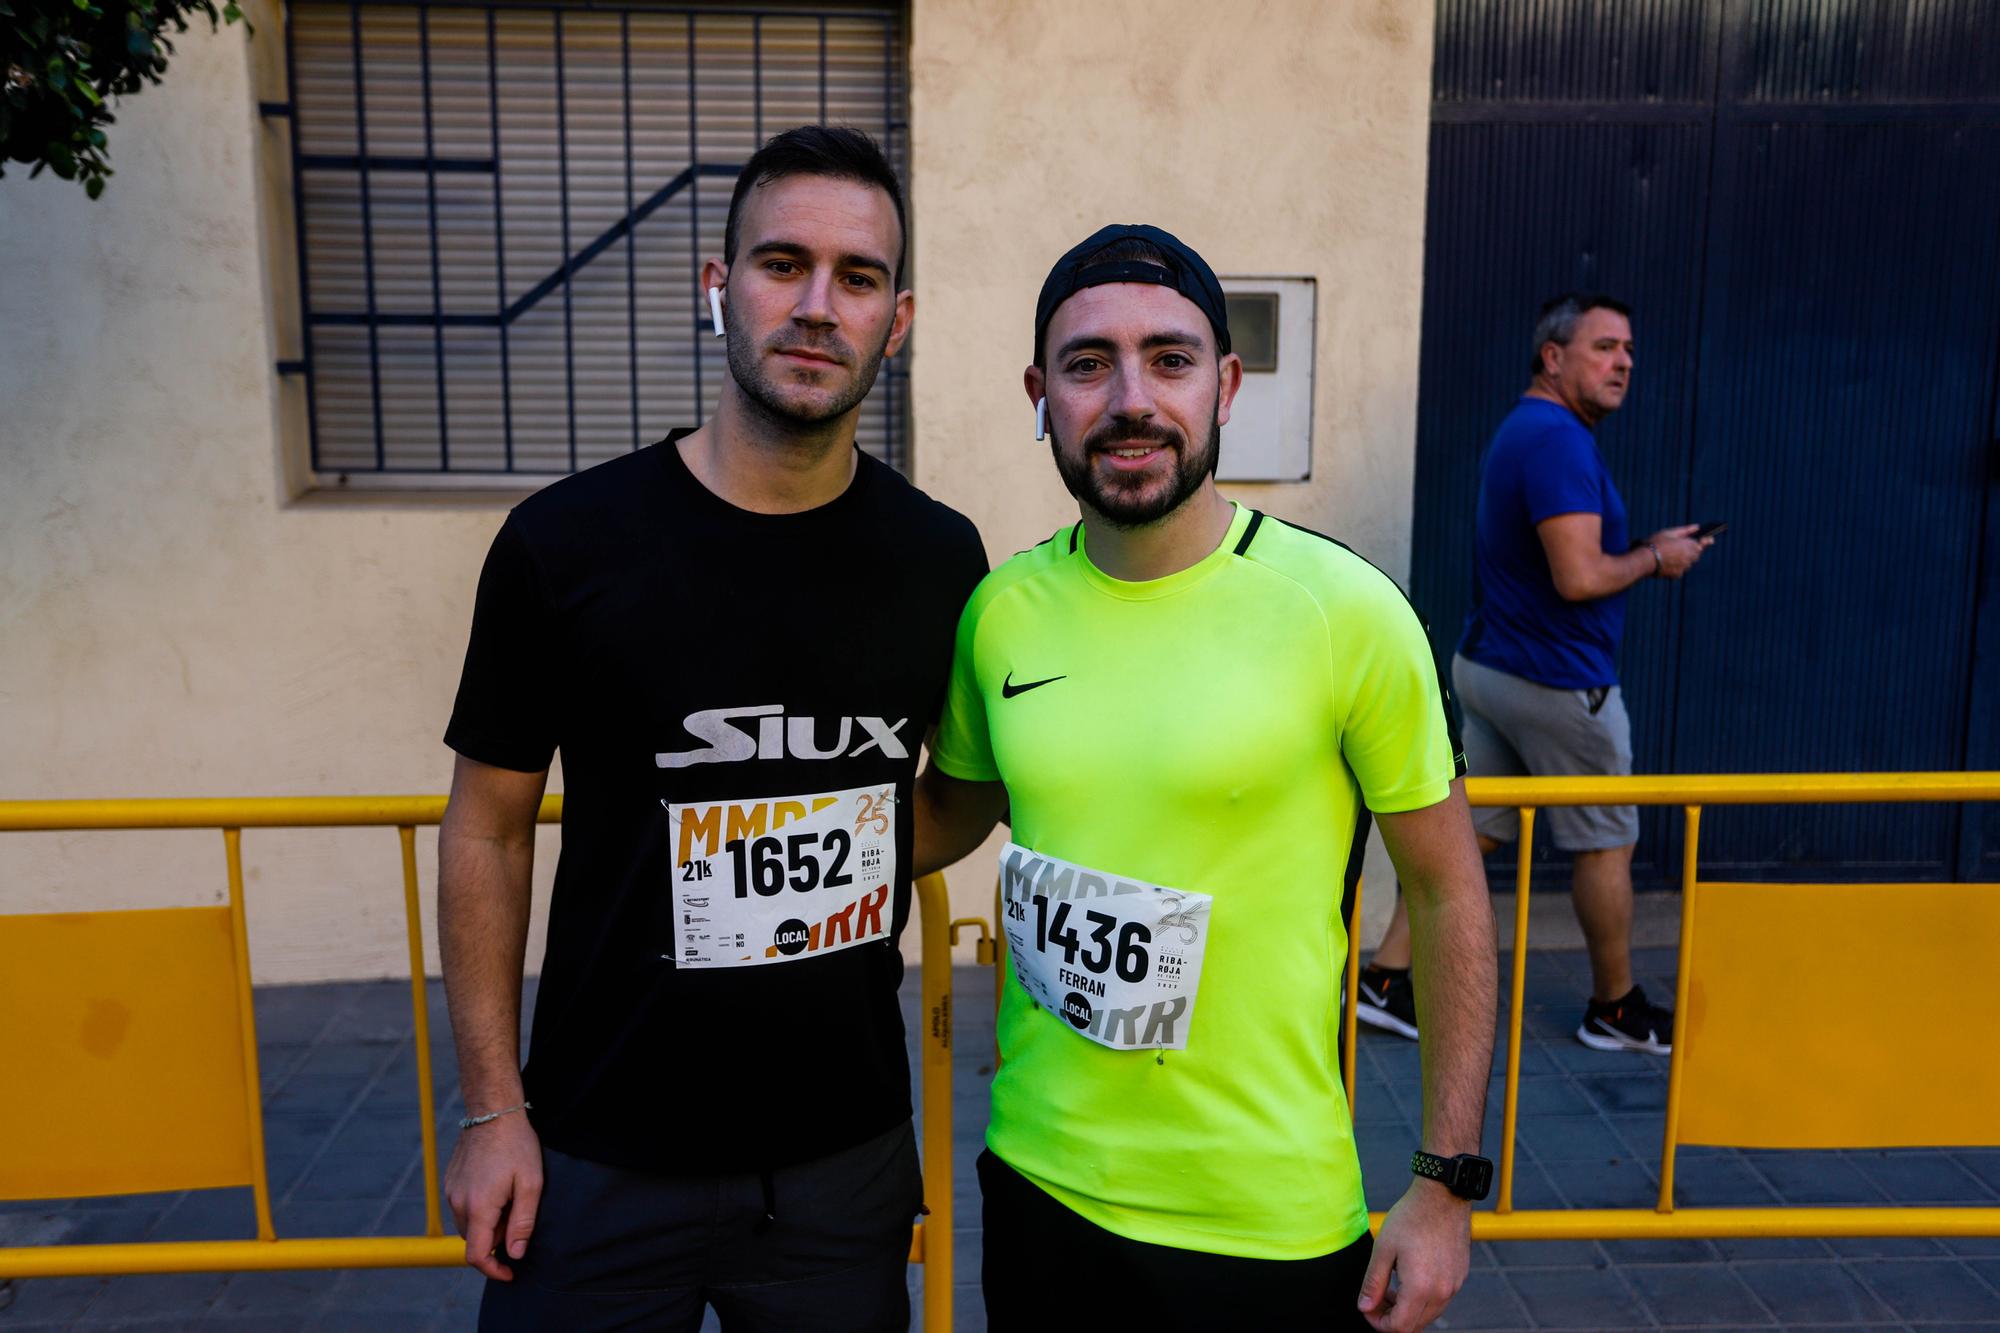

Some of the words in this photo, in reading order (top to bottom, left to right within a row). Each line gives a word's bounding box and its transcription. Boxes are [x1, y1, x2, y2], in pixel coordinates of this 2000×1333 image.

[726, 828, 853, 899] 1652
[775, 928, 809, 944] LOCAL
[1032, 895, 1152, 983] 1436
[1159, 955, 1188, 966] RIBA-
[1059, 967, 1106, 998] FERRAN
[1064, 999, 1092, 1022] LOCAL
